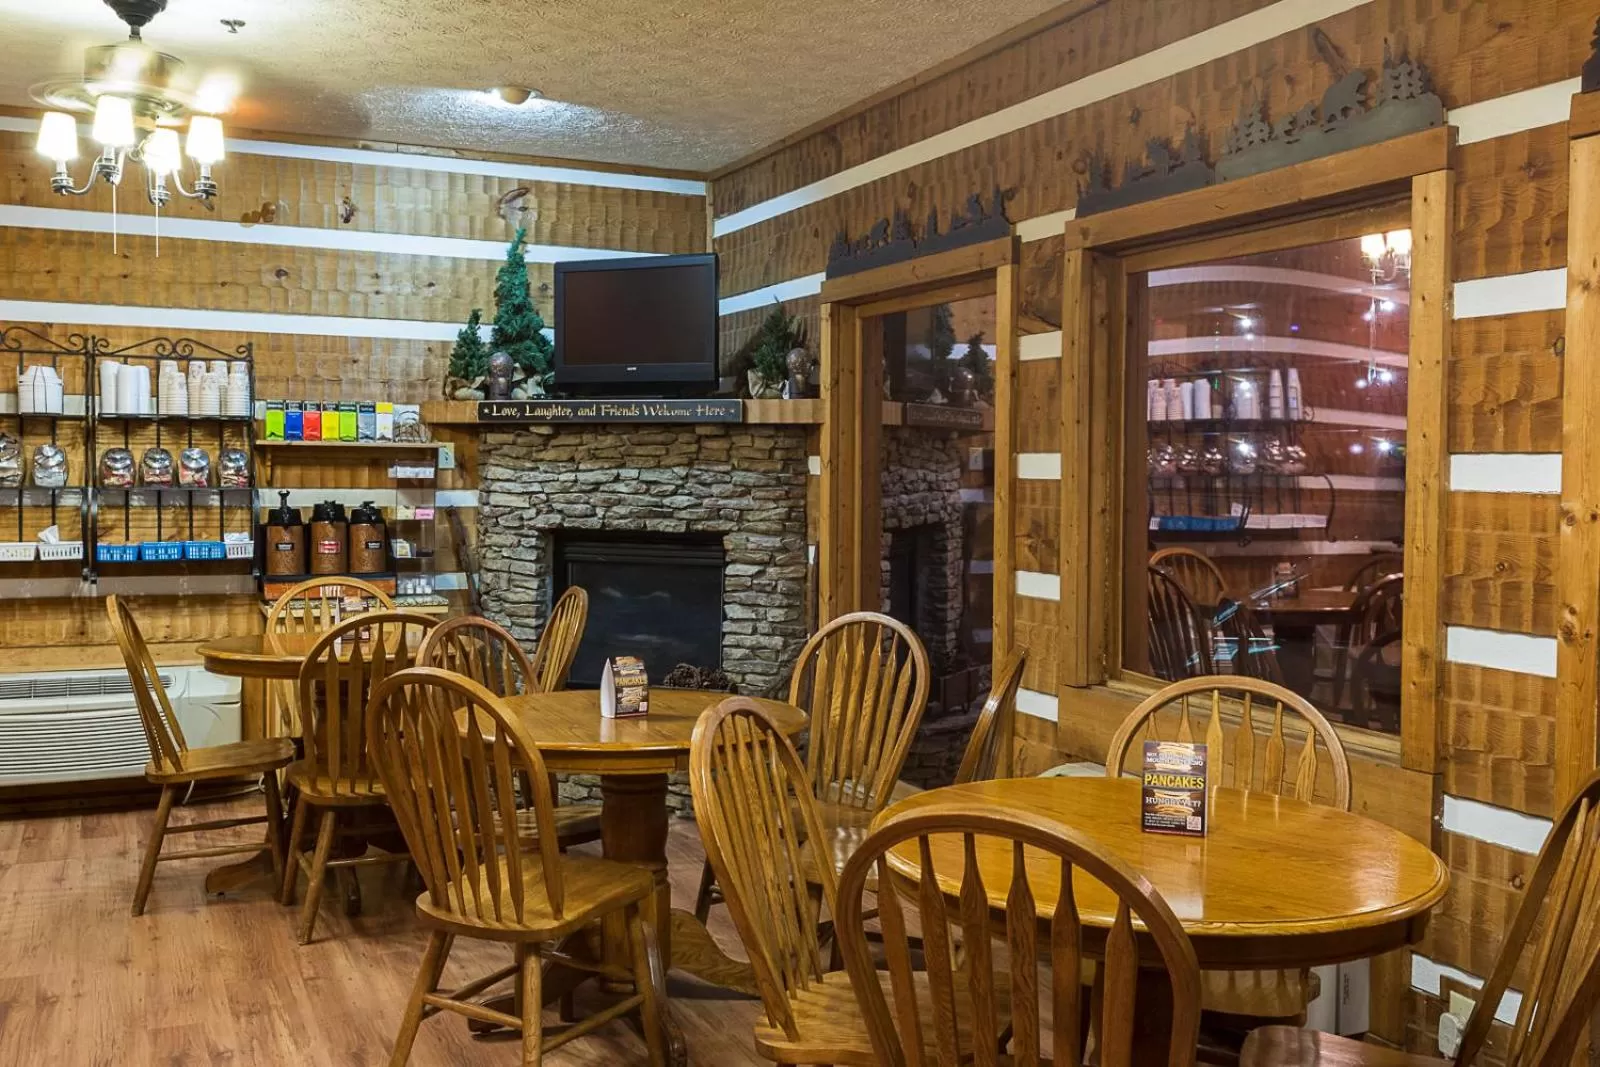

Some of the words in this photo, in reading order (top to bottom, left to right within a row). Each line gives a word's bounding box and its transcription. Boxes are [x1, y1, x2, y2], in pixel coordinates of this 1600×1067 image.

[491, 404, 520, 418] Love,
[525, 404, 574, 420] Laughter,
[577, 404, 596, 417] and
[601, 404, 640, 417] Friends
[642, 403, 692, 417] Welcome
[695, 404, 725, 417] Here
[1144, 773, 1204, 789] PANCAKES
